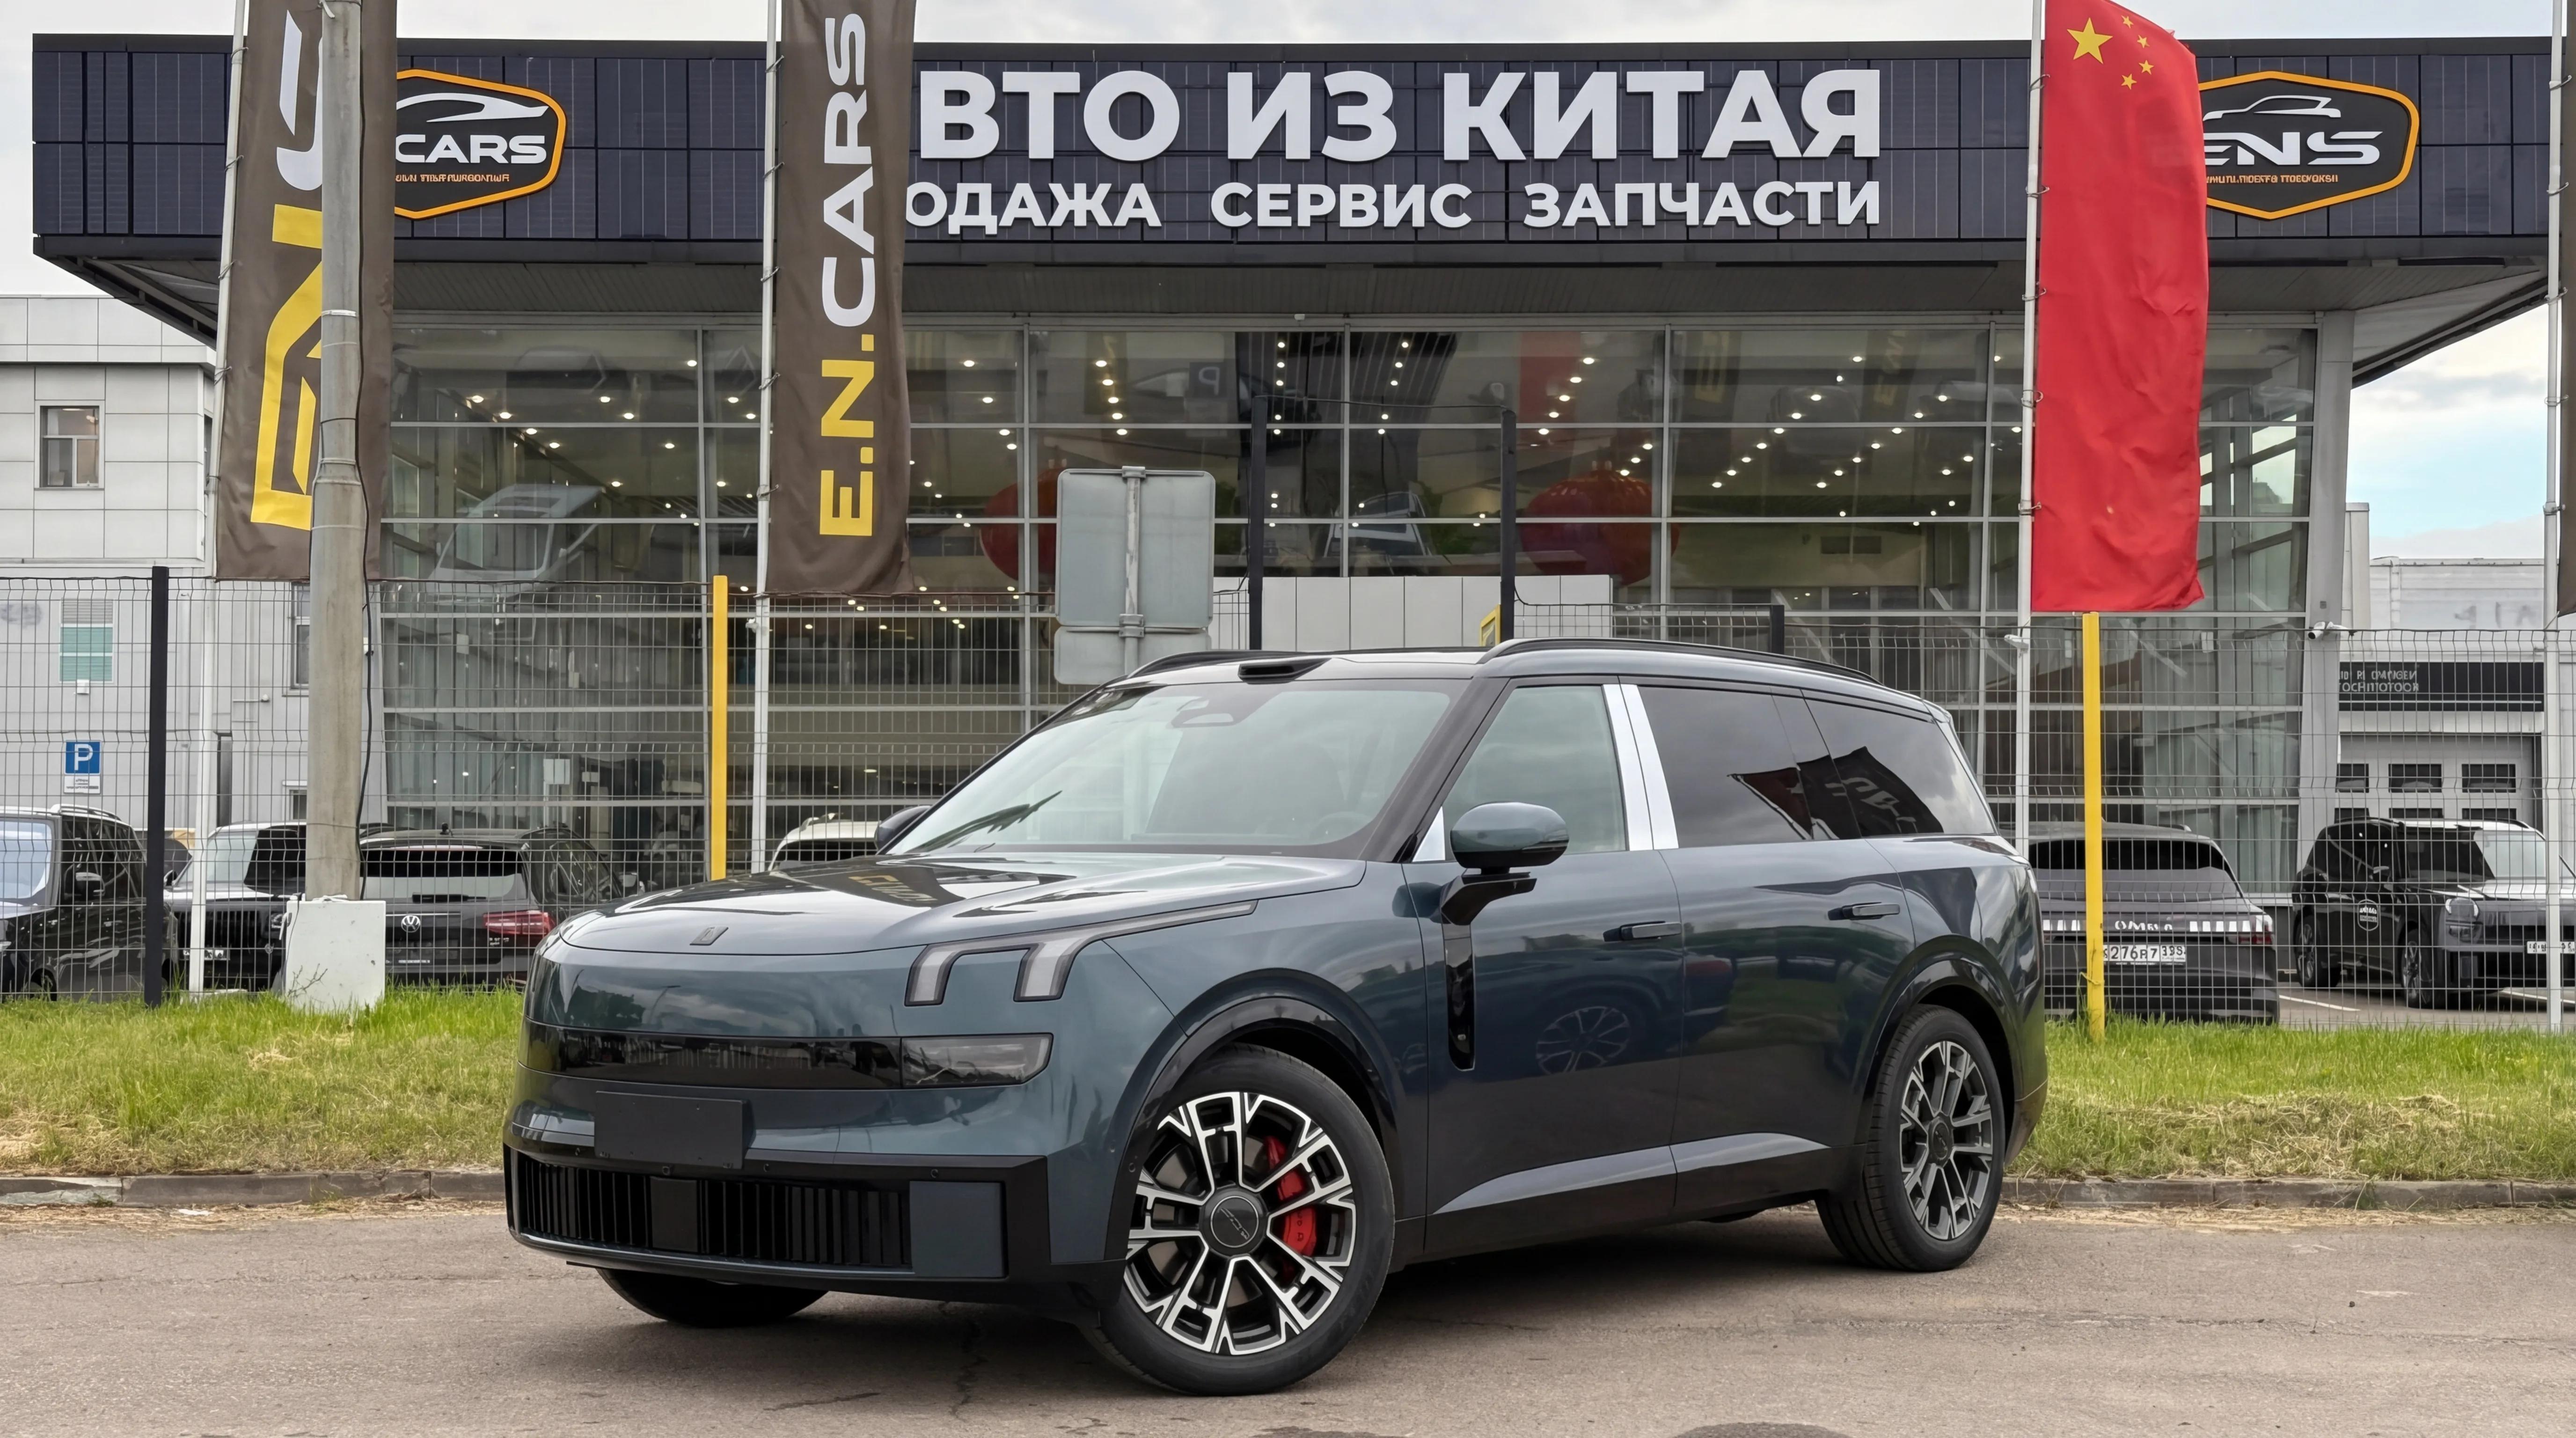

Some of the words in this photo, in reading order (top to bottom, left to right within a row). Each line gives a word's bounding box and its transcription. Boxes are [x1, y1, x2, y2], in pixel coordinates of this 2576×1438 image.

[1227, 71, 1397, 162] ИЗ
[1443, 69, 1880, 161] КИТАЯ
[1210, 182, 1472, 228] СЕРВИС
[1523, 181, 1880, 227] ЗАПЧАСТИ
[74, 743, 93, 770] P
